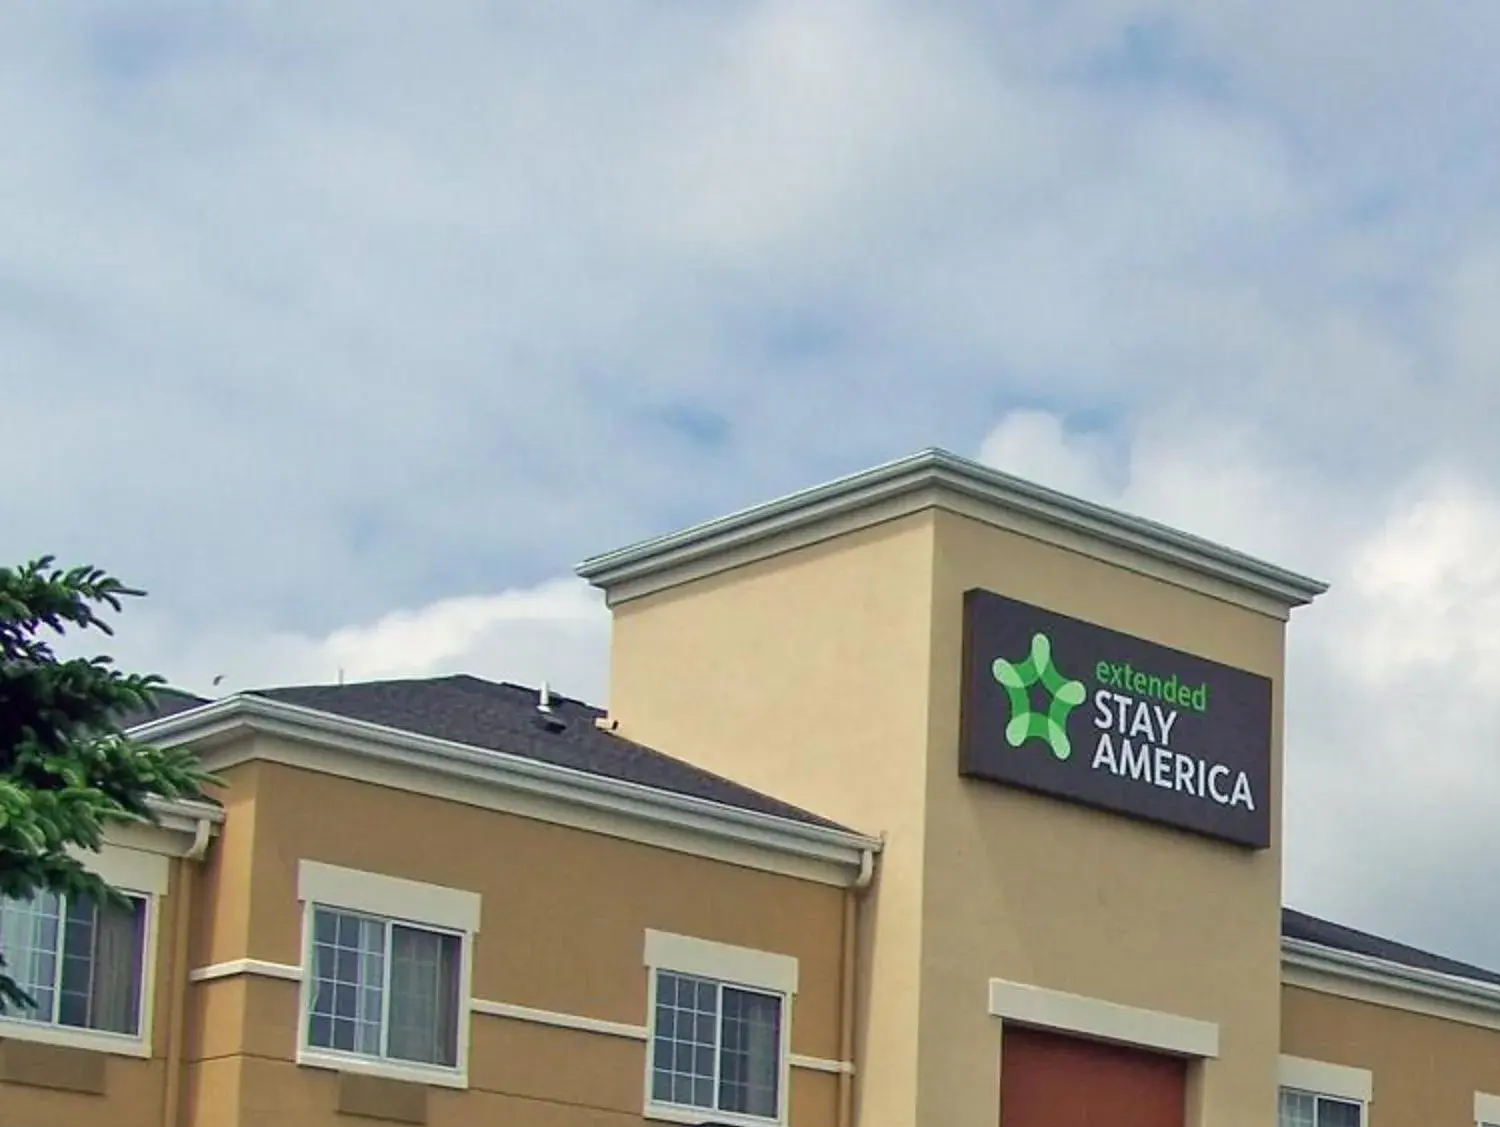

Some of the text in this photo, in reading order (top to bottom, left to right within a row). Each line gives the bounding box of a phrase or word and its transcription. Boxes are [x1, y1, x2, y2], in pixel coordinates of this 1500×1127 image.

[1096, 661, 1207, 711] extended
[1094, 689, 1177, 745] STAY
[1092, 733, 1255, 811] AMERICA
